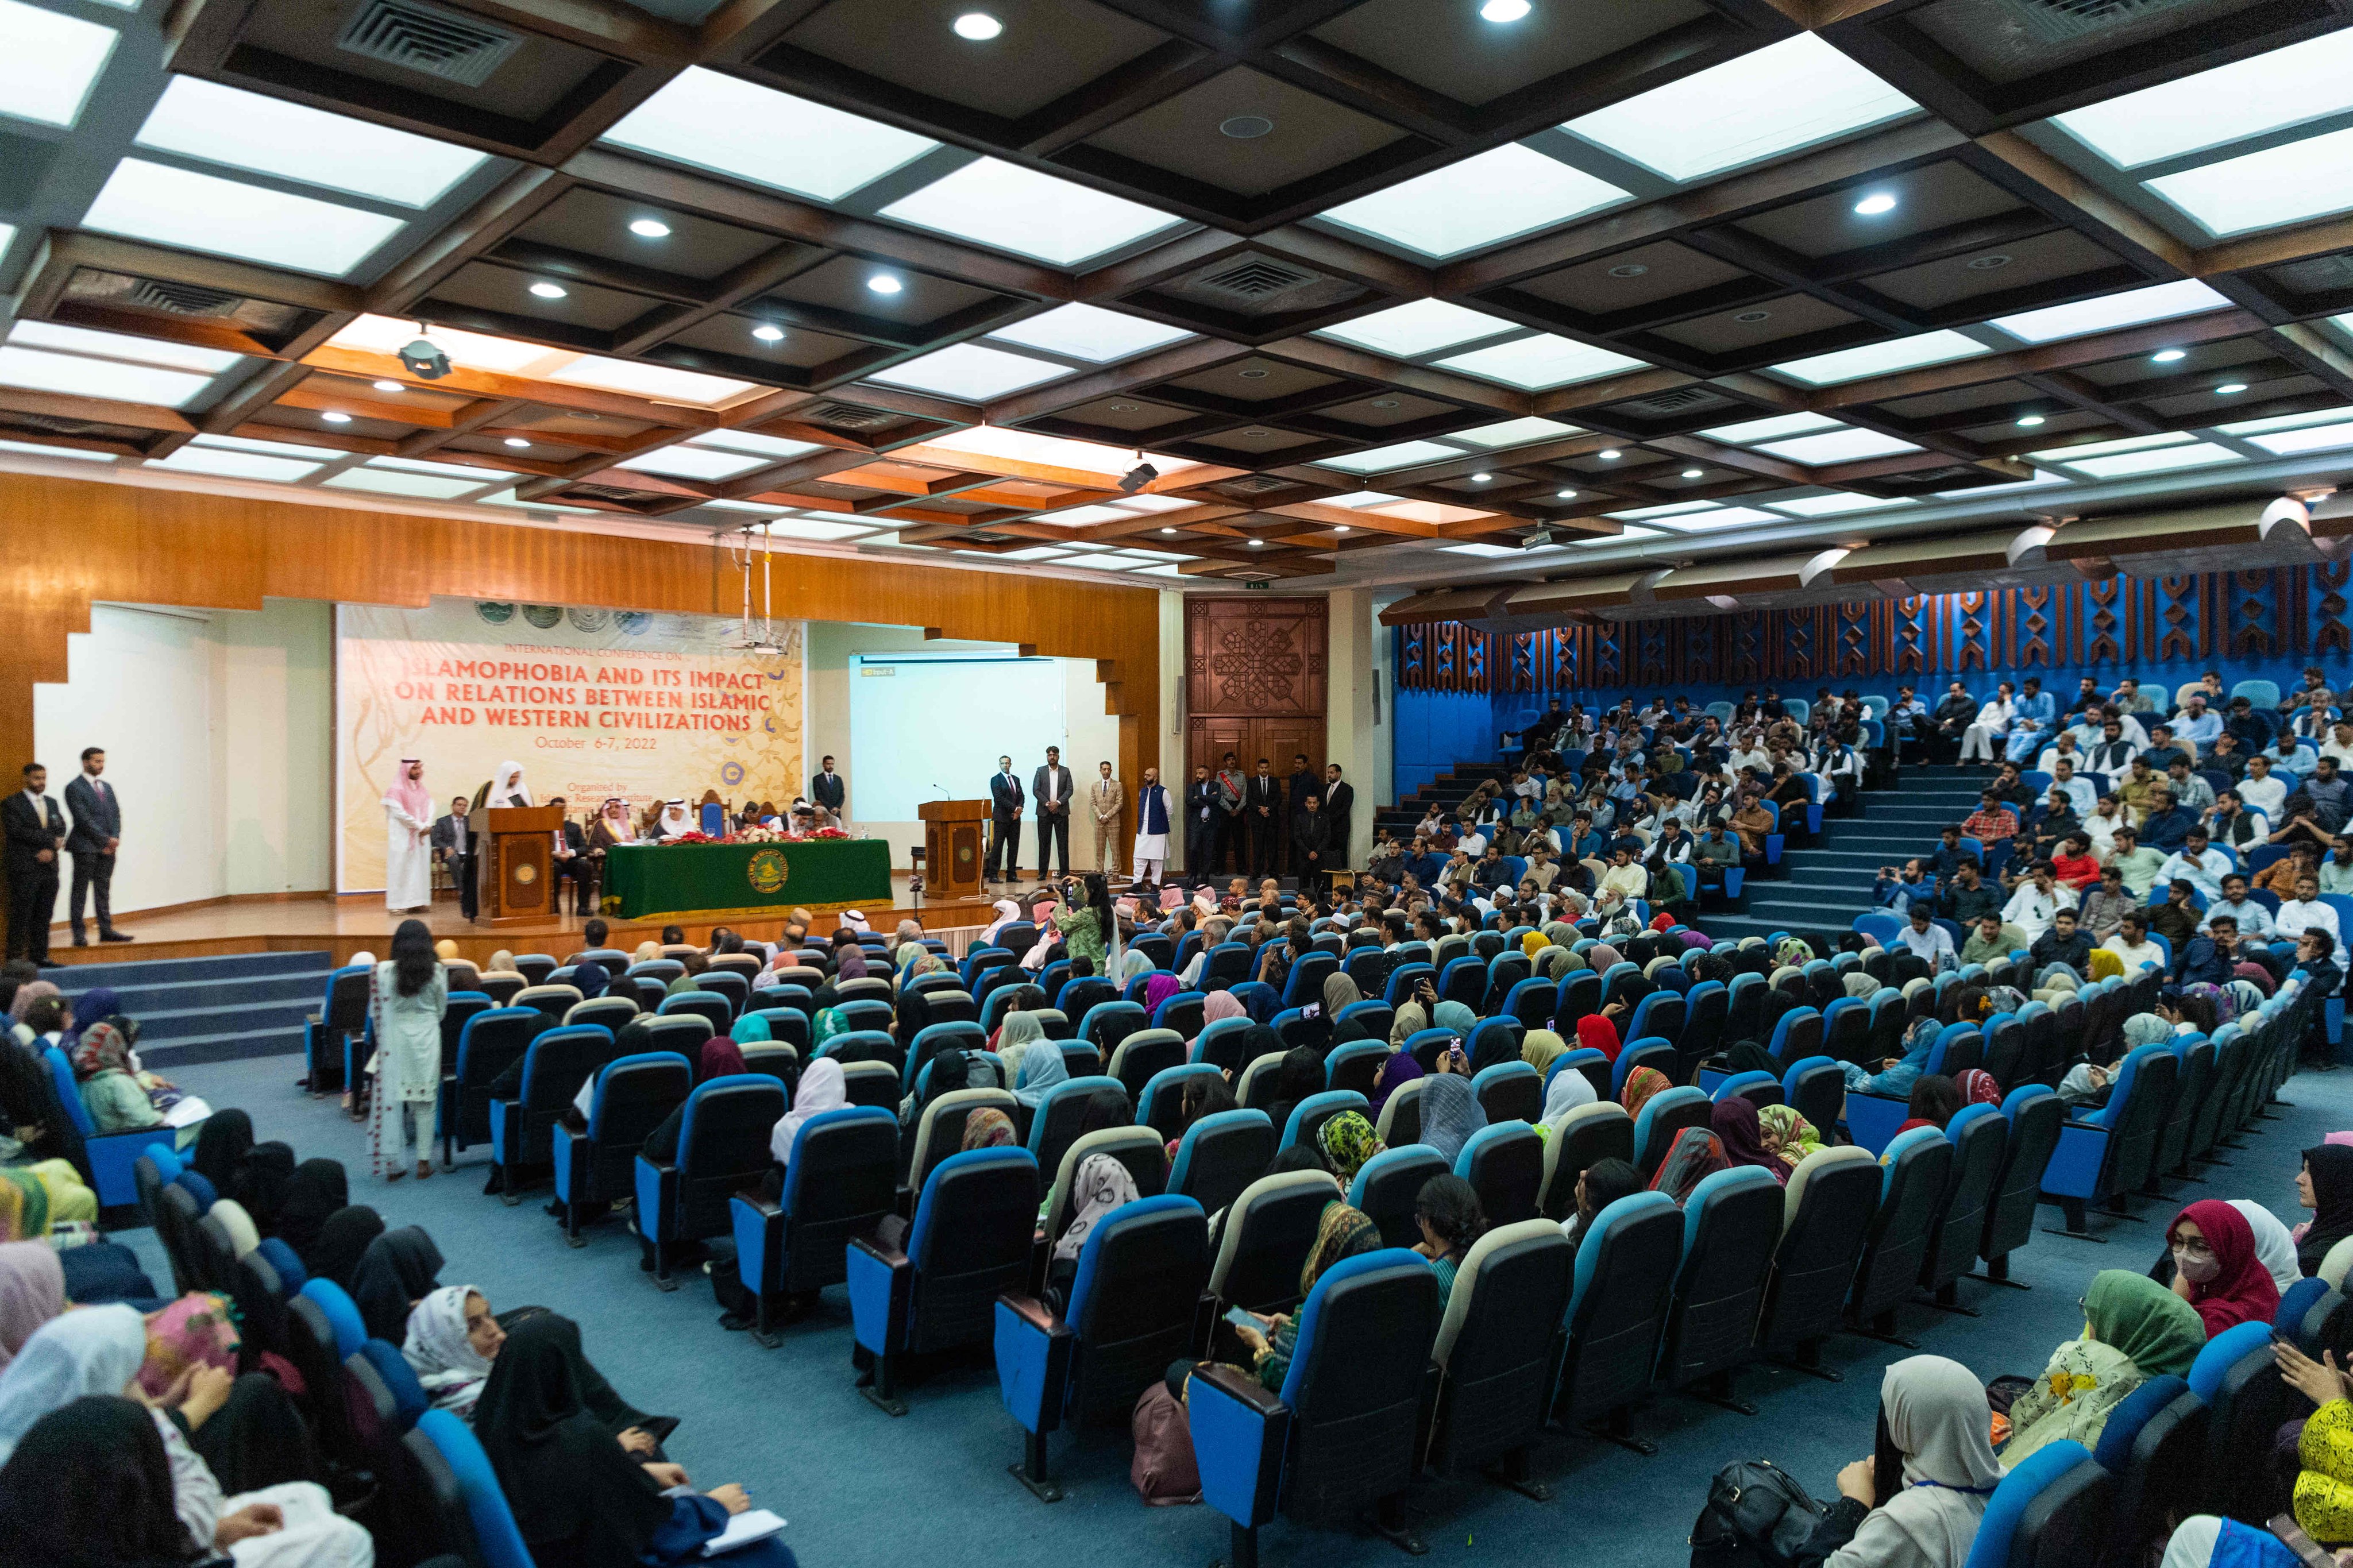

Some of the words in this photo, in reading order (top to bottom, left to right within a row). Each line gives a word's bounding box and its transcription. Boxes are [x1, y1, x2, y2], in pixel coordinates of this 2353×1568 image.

[505, 643, 594, 656] INTERNATIONAL
[597, 648, 663, 660] CONFERENCE
[666, 652, 682, 661] ON
[403, 658, 589, 682] ISLAMOPHOBIA
[596, 667, 644, 685] AND
[653, 669, 681, 686] ITS
[690, 671, 764, 689] IMPACT
[395, 681, 435, 700] ON
[446, 683, 576, 705] RELATIONS
[585, 689, 682, 708] BETWEEN
[692, 692, 770, 711] ISLAMIC
[420, 706, 476, 725] AND
[484, 708, 589, 728] WESTERN
[599, 711, 751, 731] CIVILIZATIONS
[535, 736, 587, 749] October
[594, 737, 620, 752] 6-7,
[624, 738, 657, 750] 2022
[566, 782, 614, 793] Organized
[616, 783, 627, 793] by
